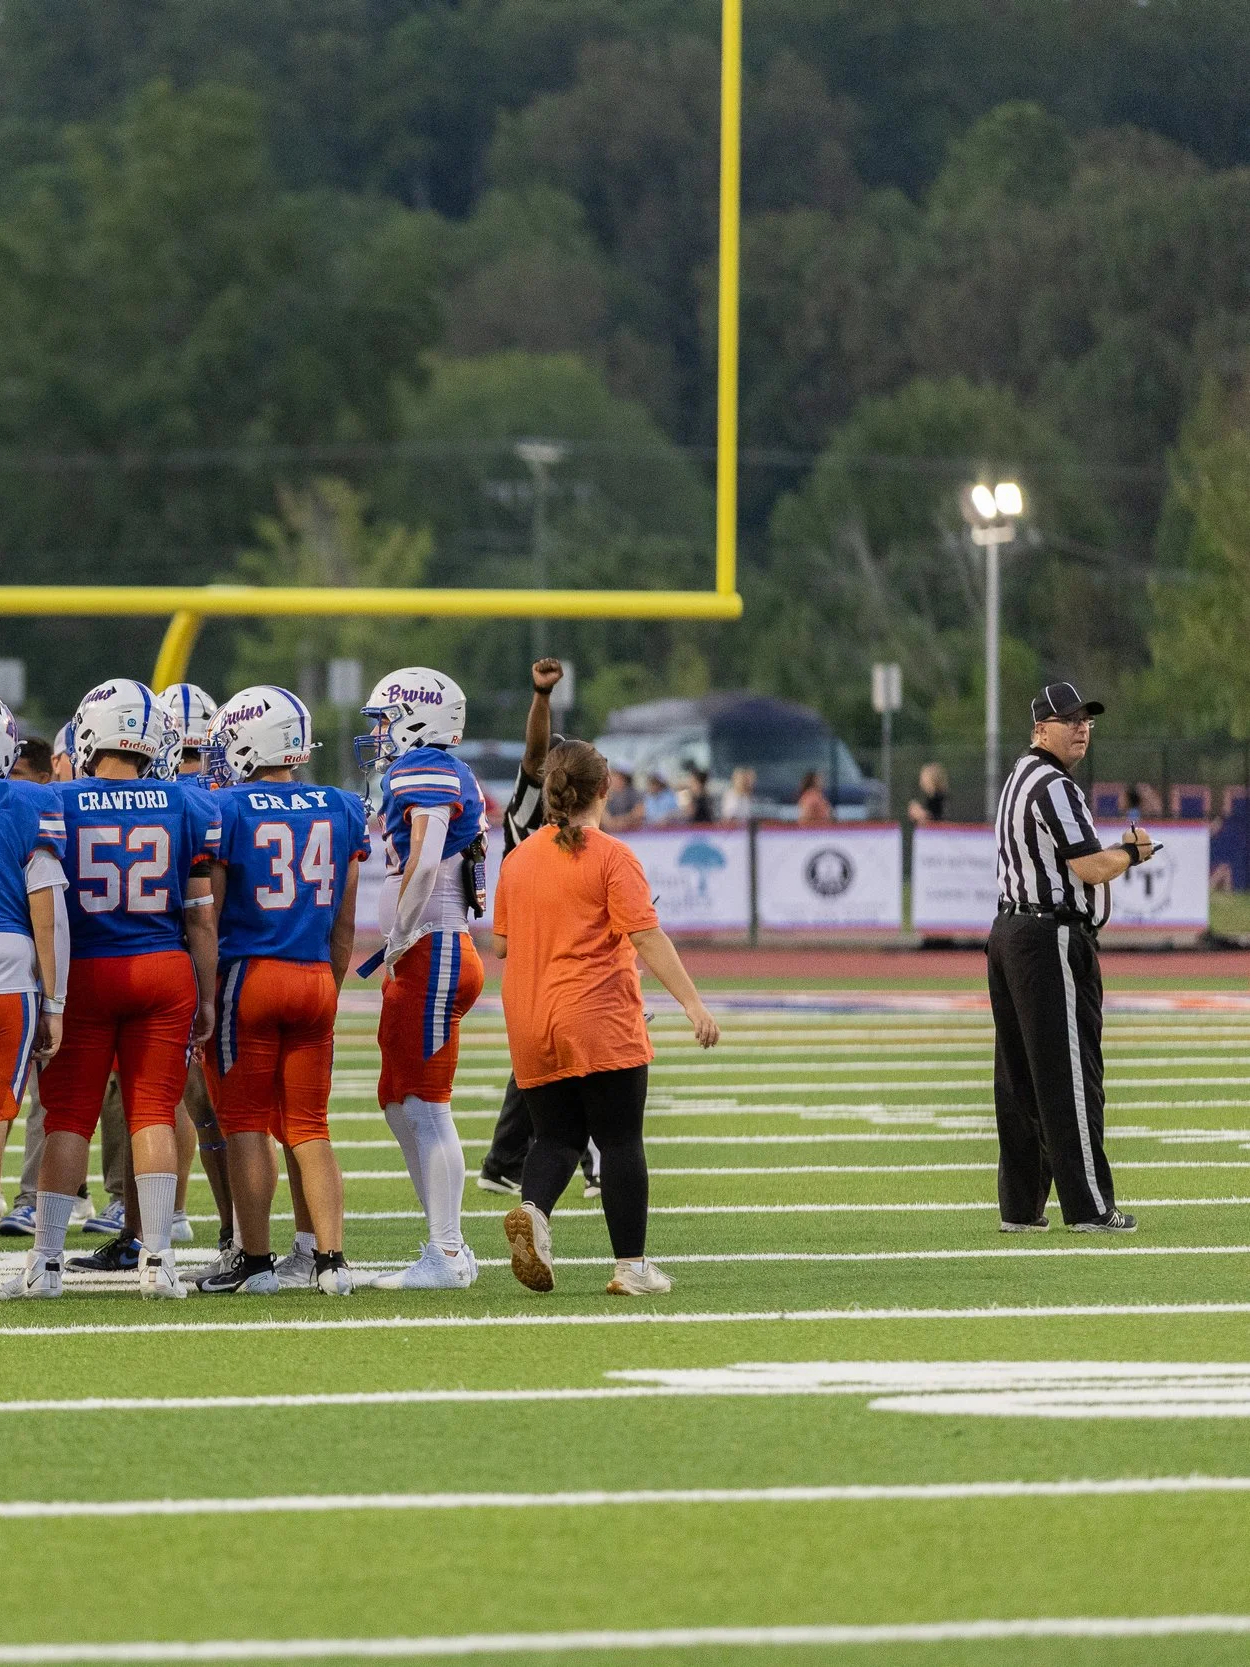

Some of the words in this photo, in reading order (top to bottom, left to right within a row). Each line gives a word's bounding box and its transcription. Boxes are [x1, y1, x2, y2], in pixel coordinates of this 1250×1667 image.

[387, 684, 444, 706] Bruins
[220, 697, 264, 731] Bruins
[119, 739, 156, 754] Riddell
[77, 790, 169, 811] CRAWFORD
[248, 791, 330, 811] GRAY
[77, 825, 171, 915] 52
[254, 820, 335, 911] 34
